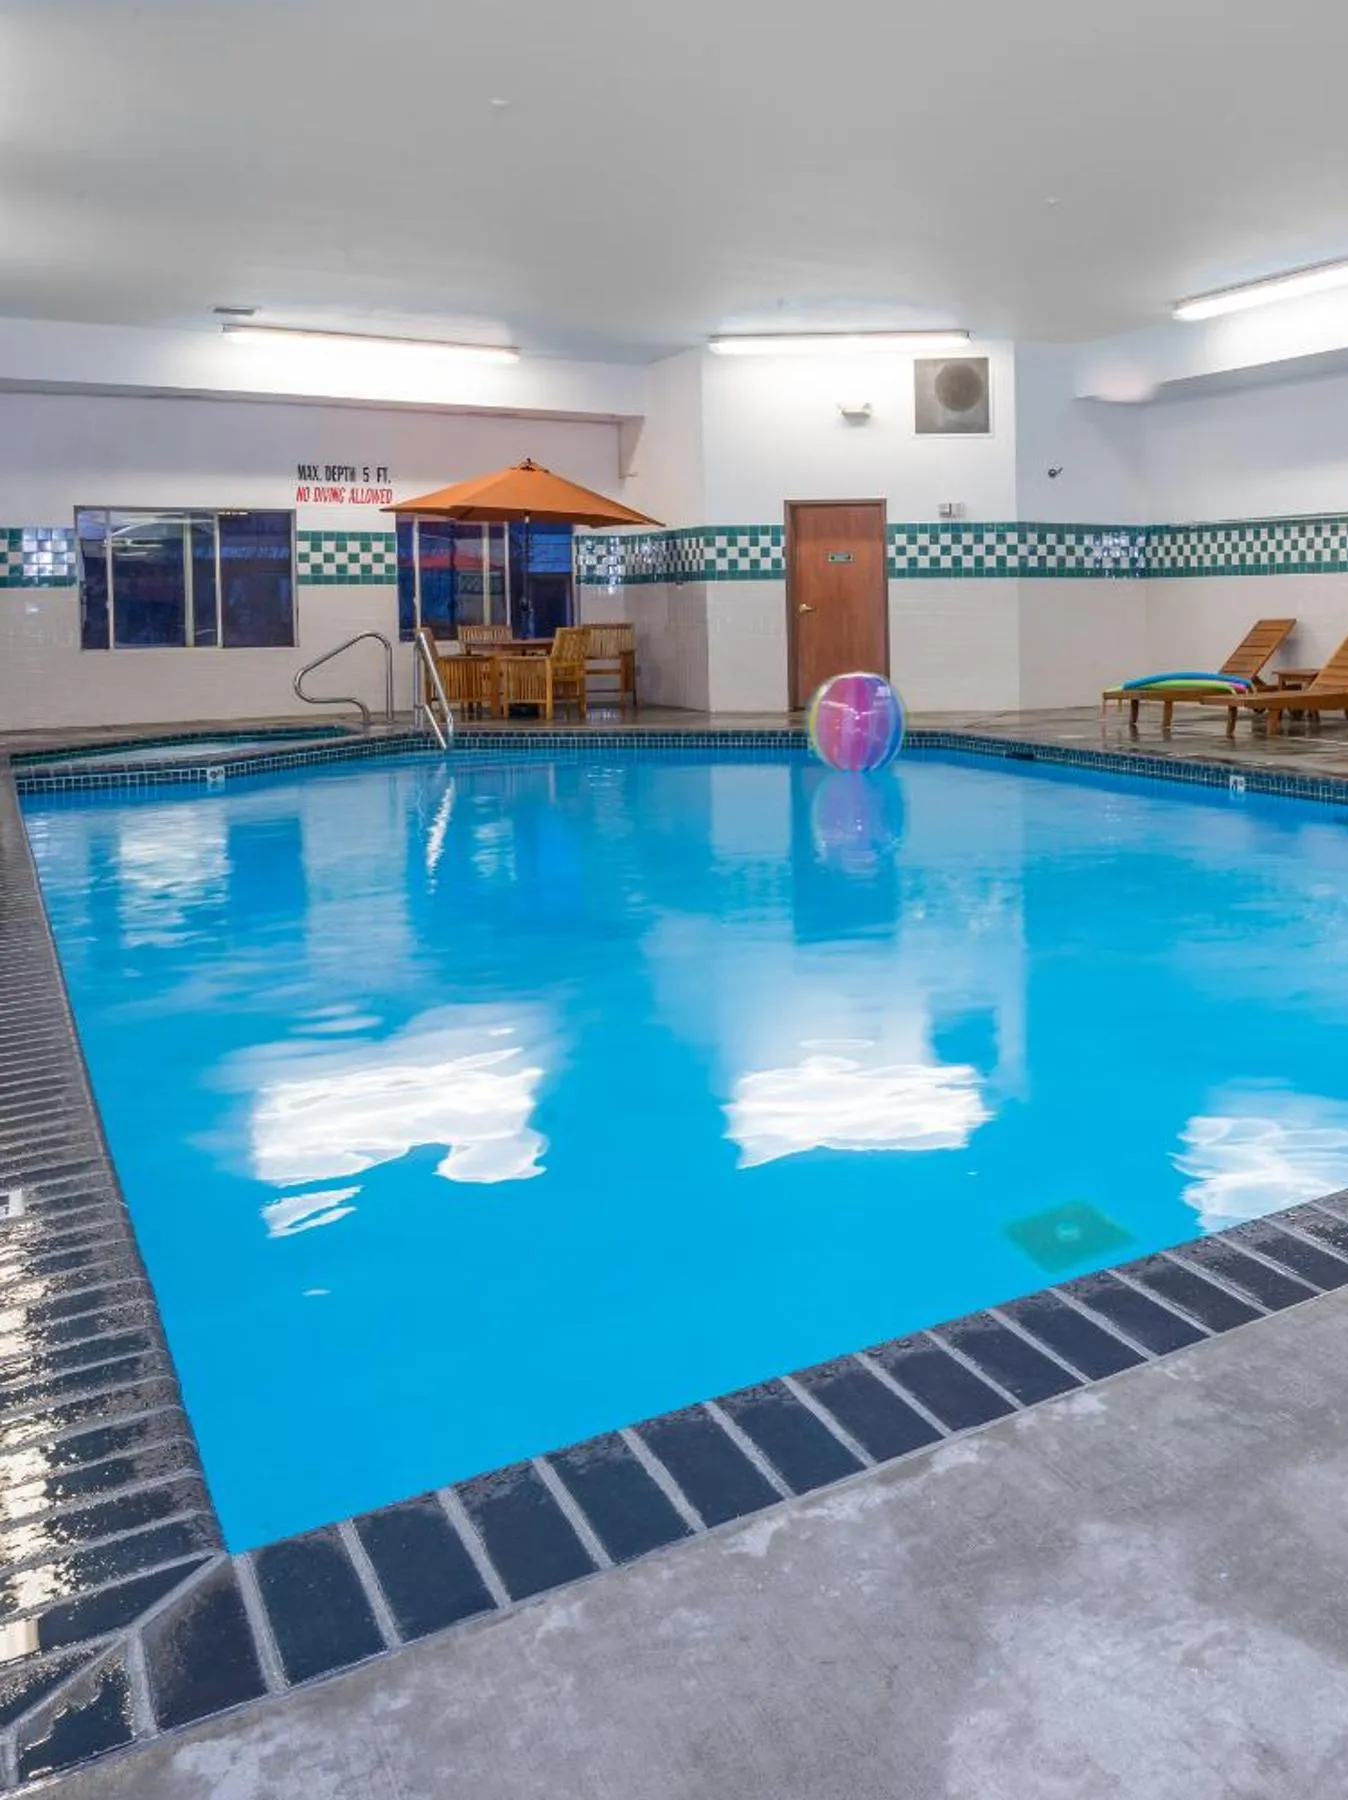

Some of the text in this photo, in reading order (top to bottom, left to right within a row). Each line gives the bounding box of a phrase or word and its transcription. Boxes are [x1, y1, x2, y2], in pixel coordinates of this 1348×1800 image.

[297, 464, 392, 484] MAX. DEPTH 5 FT.
[296, 486, 393, 504] NO DIVING ALLOWED
